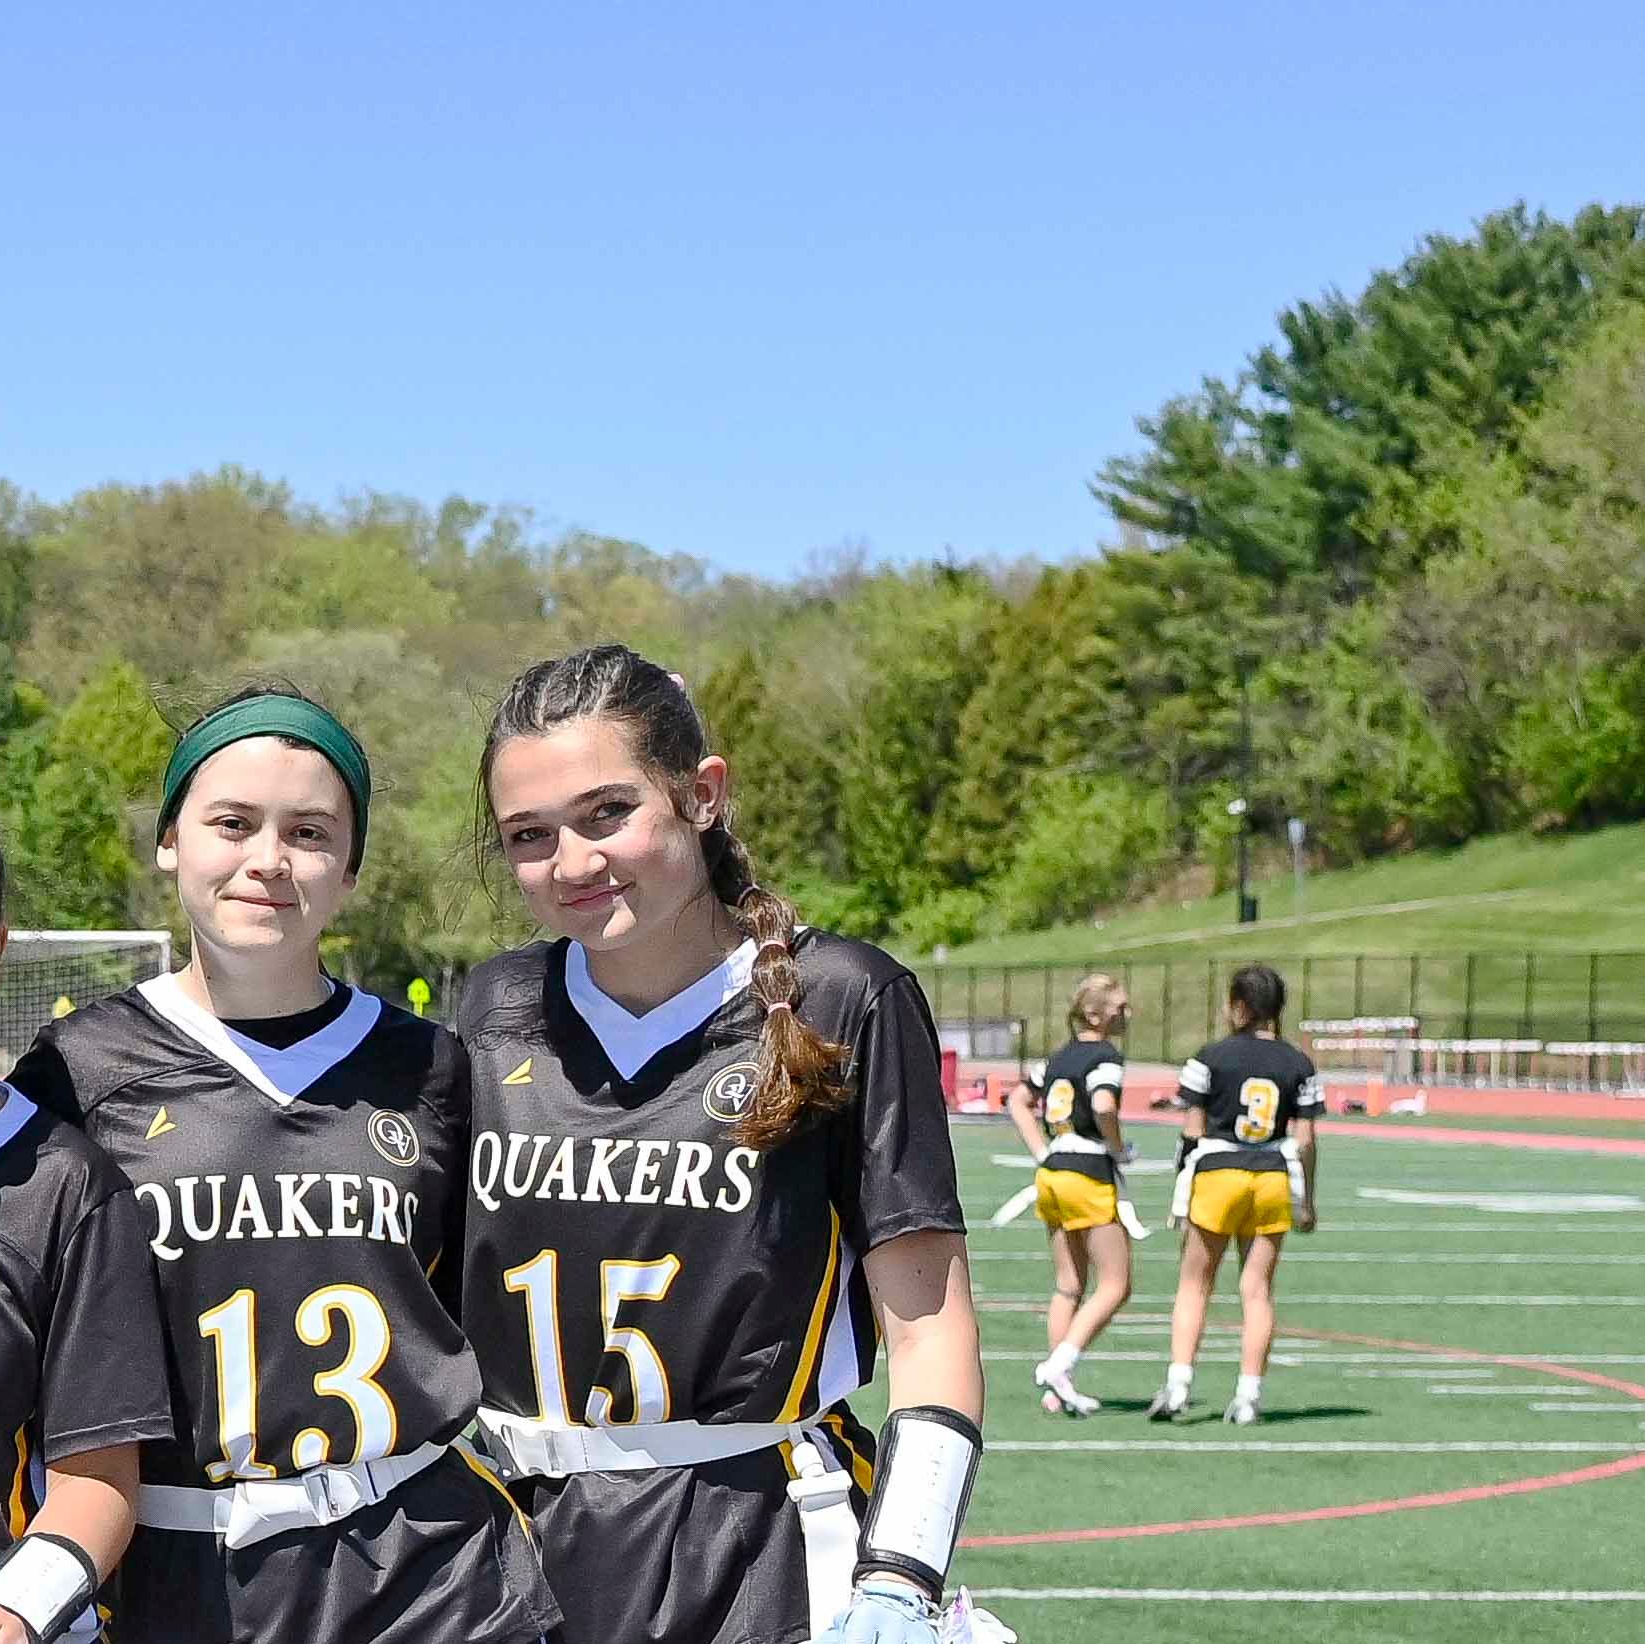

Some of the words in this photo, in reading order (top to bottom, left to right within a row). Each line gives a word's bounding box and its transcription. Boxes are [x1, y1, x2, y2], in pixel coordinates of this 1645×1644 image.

[471, 1130, 760, 1213] QUAKERS
[1234, 1077, 1280, 1143] 3
[198, 1282, 398, 1481] 13
[504, 1248, 681, 1427] 15
